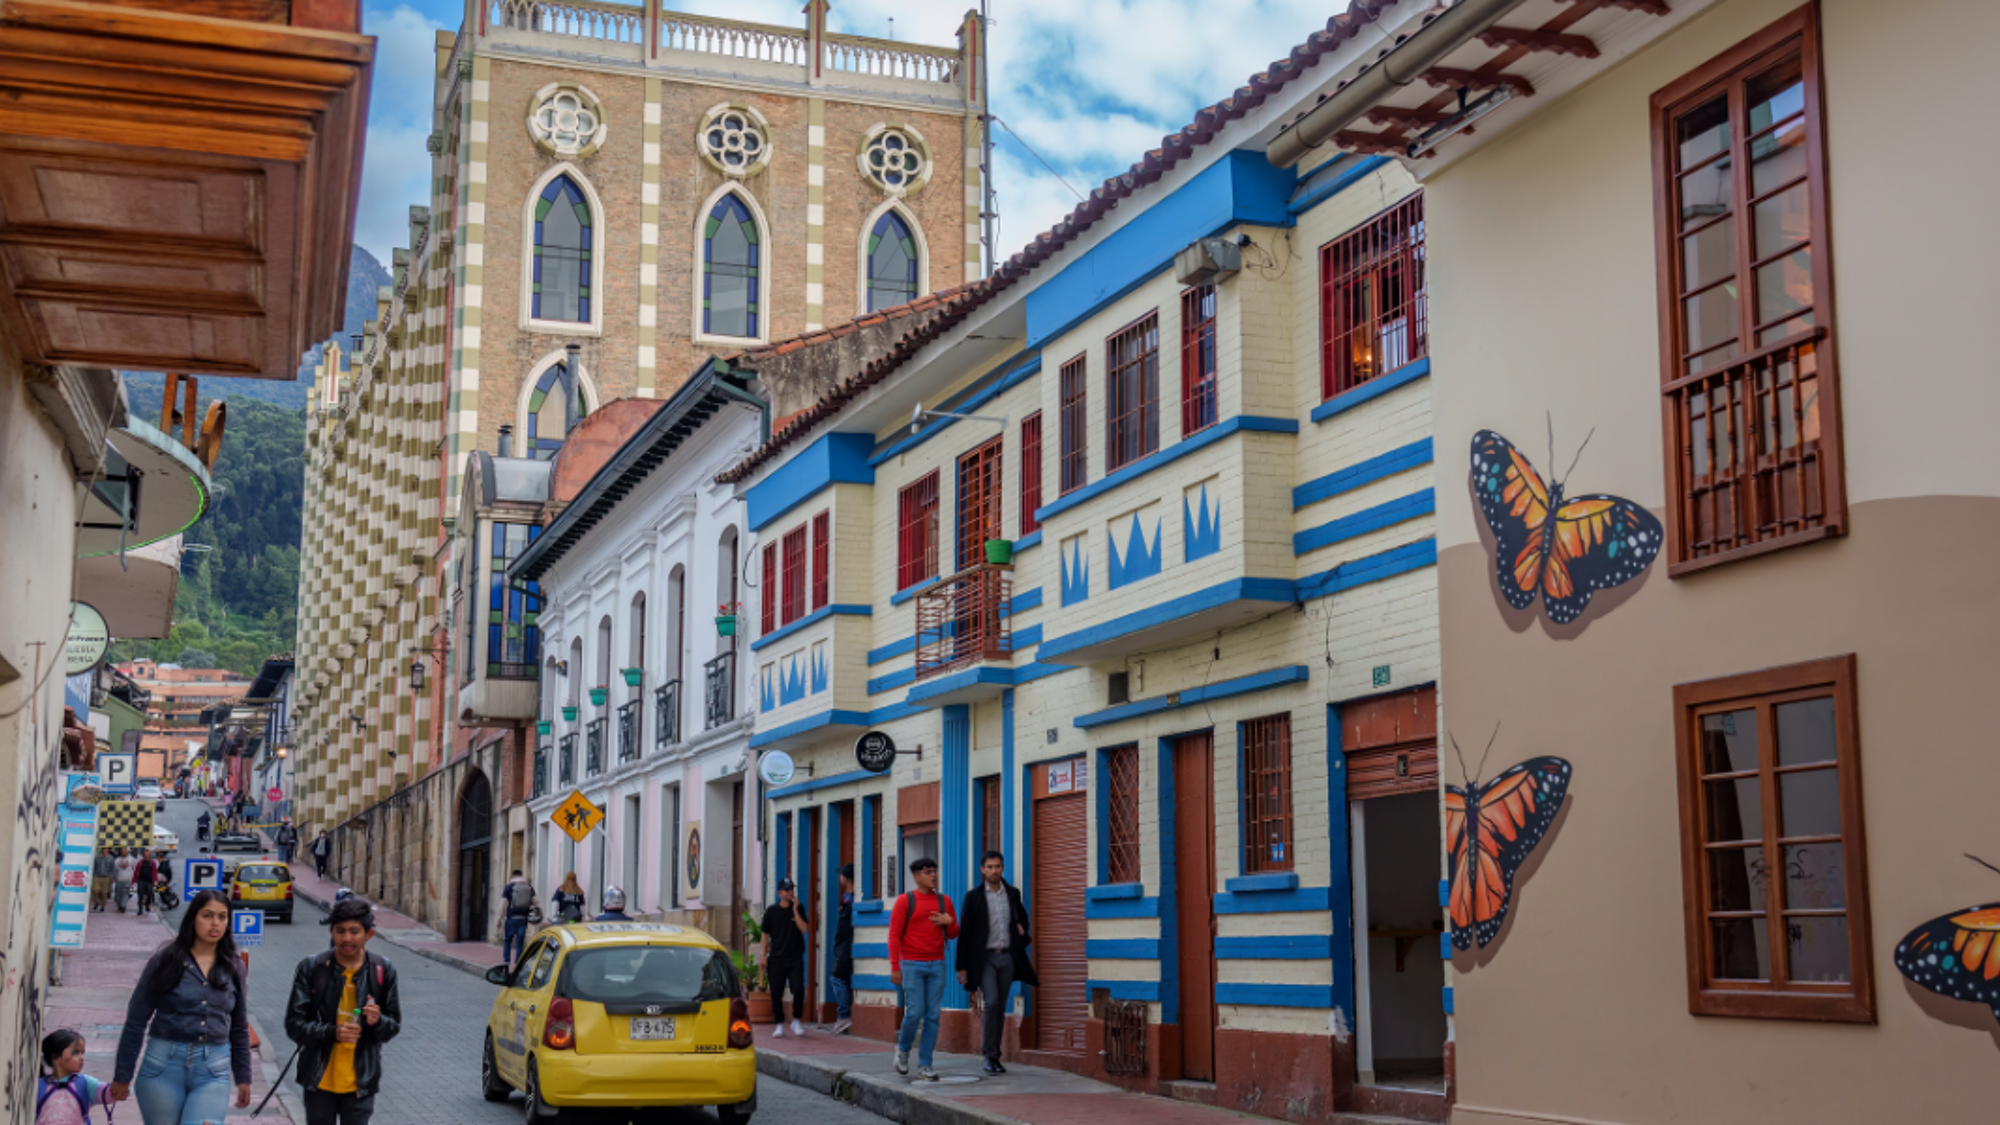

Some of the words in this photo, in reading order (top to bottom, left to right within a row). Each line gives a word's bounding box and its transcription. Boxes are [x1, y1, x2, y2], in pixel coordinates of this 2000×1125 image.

[109, 759, 125, 782] P
[193, 864, 215, 885] P
[239, 914, 257, 933] P
